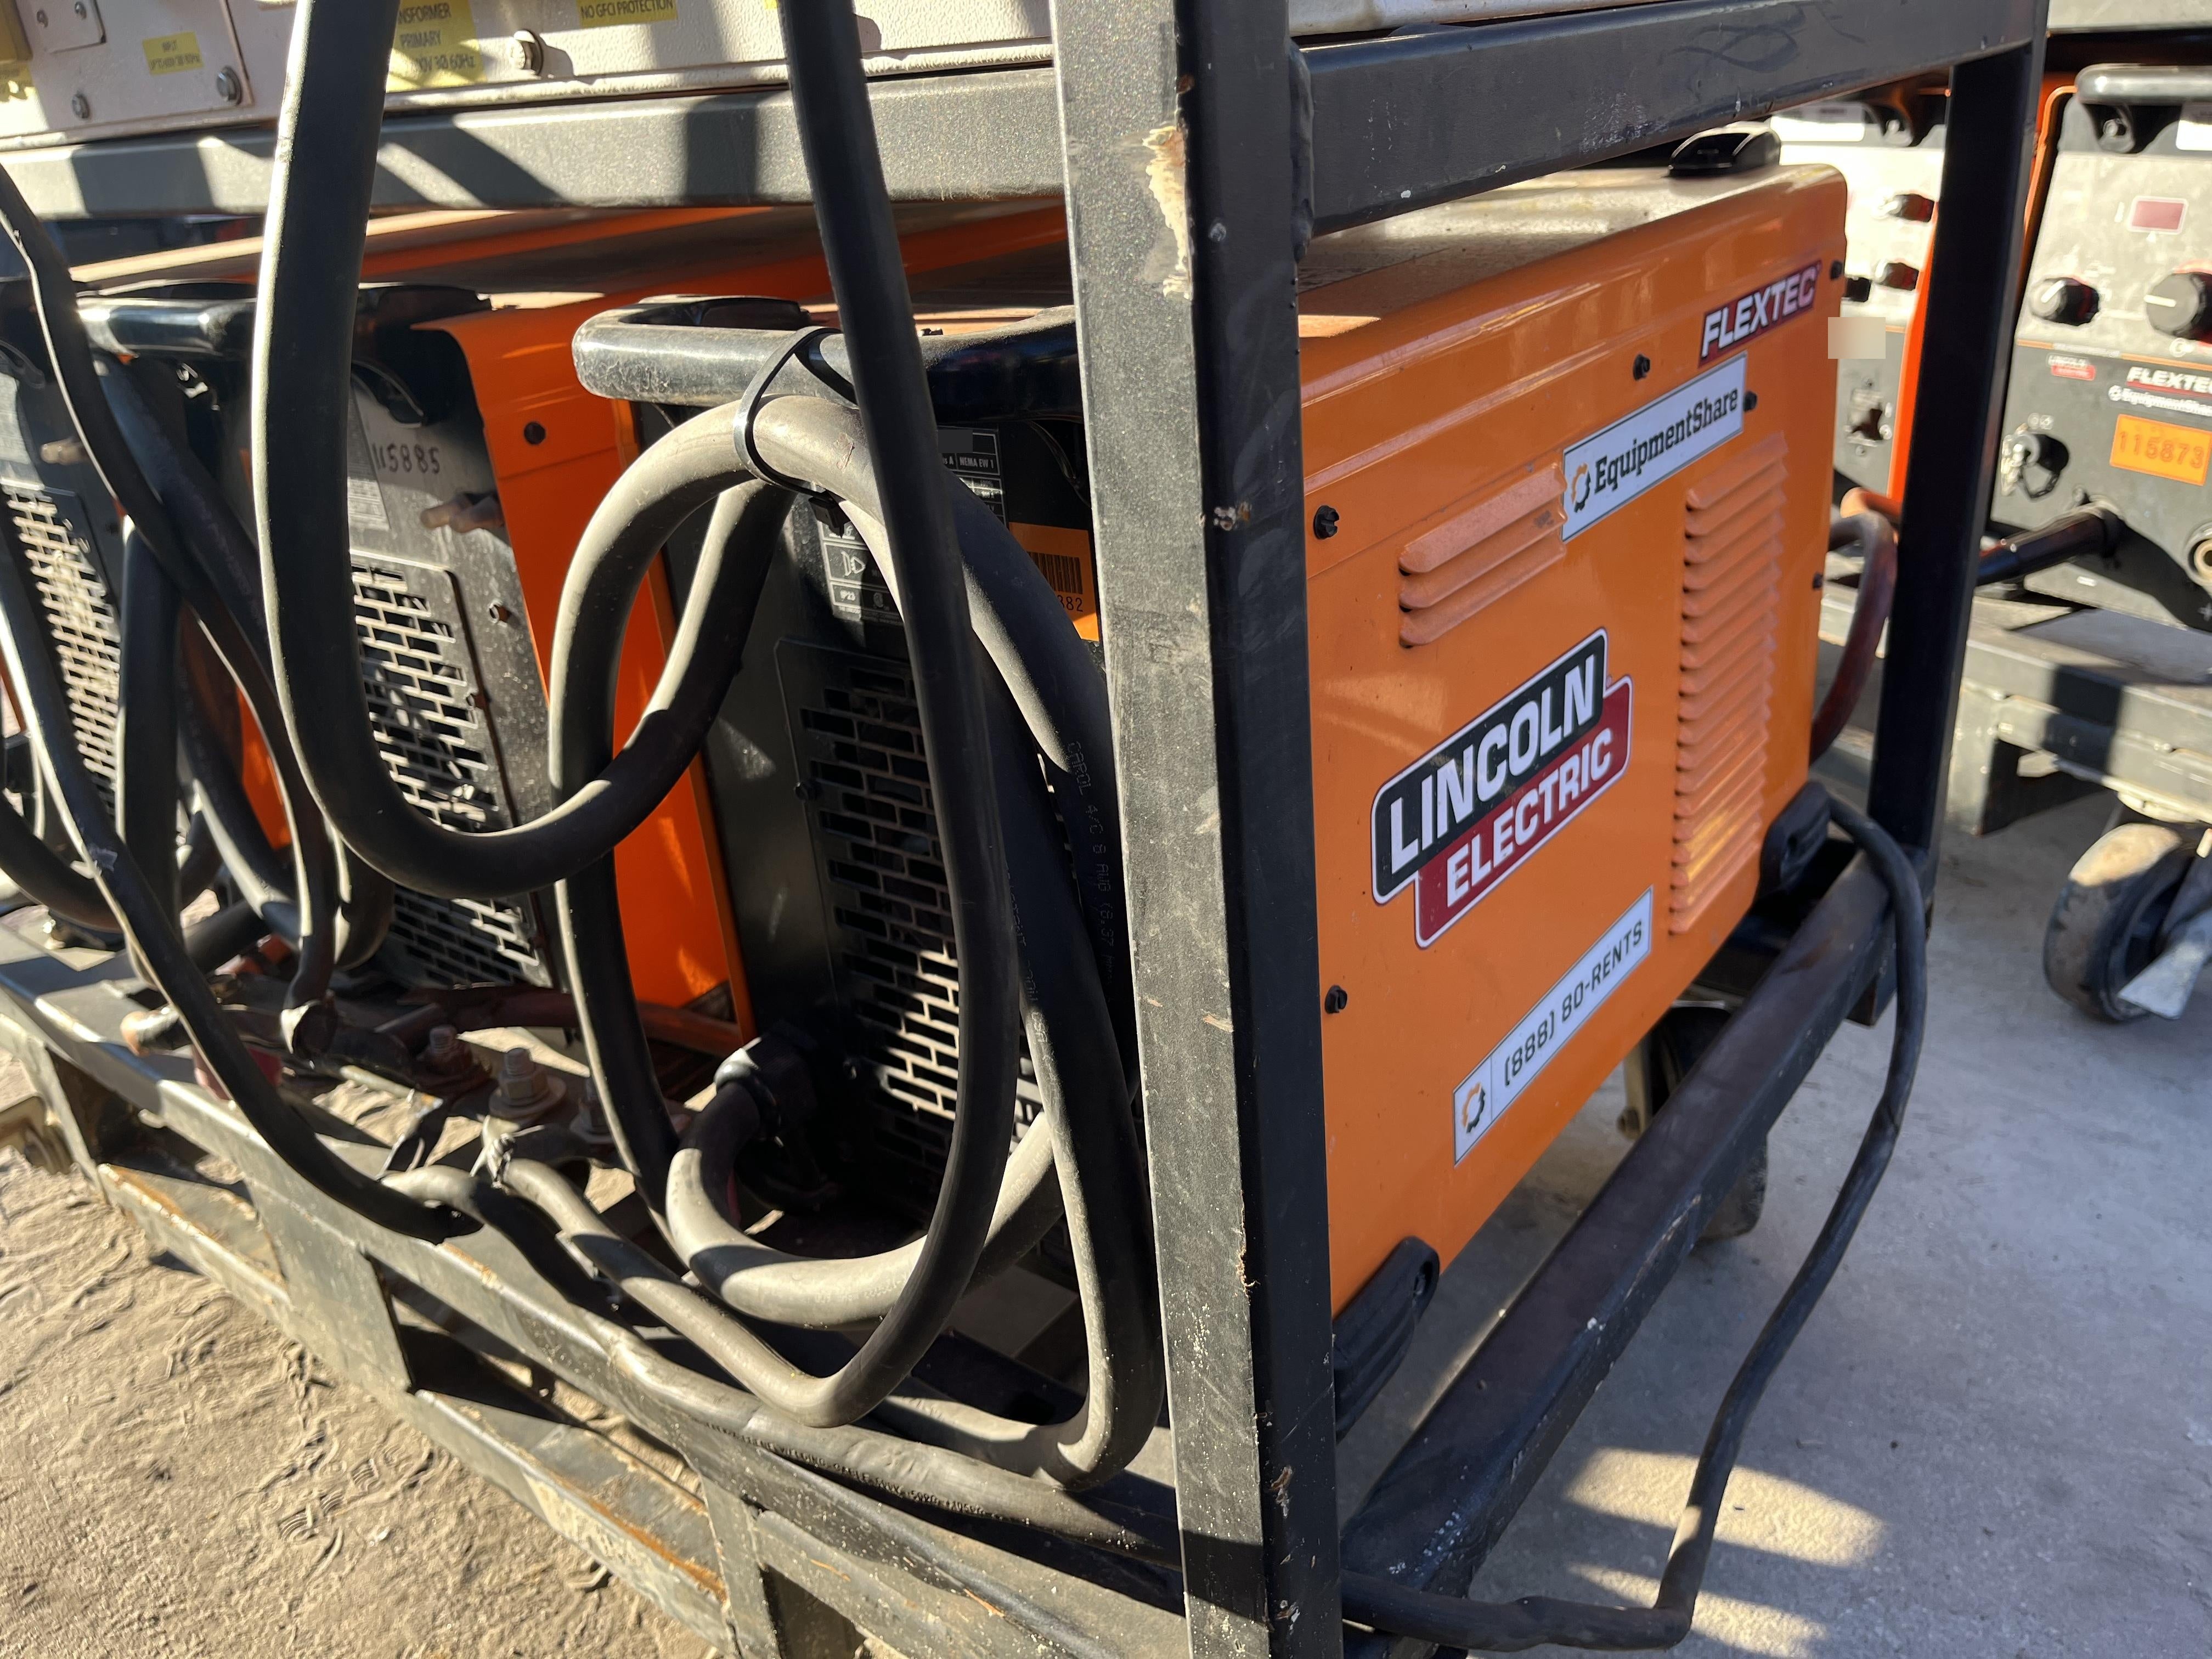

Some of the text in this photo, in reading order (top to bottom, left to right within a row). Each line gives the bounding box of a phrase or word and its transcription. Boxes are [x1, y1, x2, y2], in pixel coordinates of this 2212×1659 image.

[399, 3, 451, 24] NSFORMER
[400, 30, 441, 48] PRIMARY
[581, 0, 673, 19] NO GFCI PROTECTION
[1701, 266, 1817, 359] FLEXTEC
[960, 456, 978, 467] NEMA
[1594, 387, 1739, 494] EquipmentShare
[1390, 654, 1595, 875] LINCOLN
[1447, 727, 1612, 909] ELECTRIC
[1504, 920, 1643, 1087] (888) 80-RENTS
